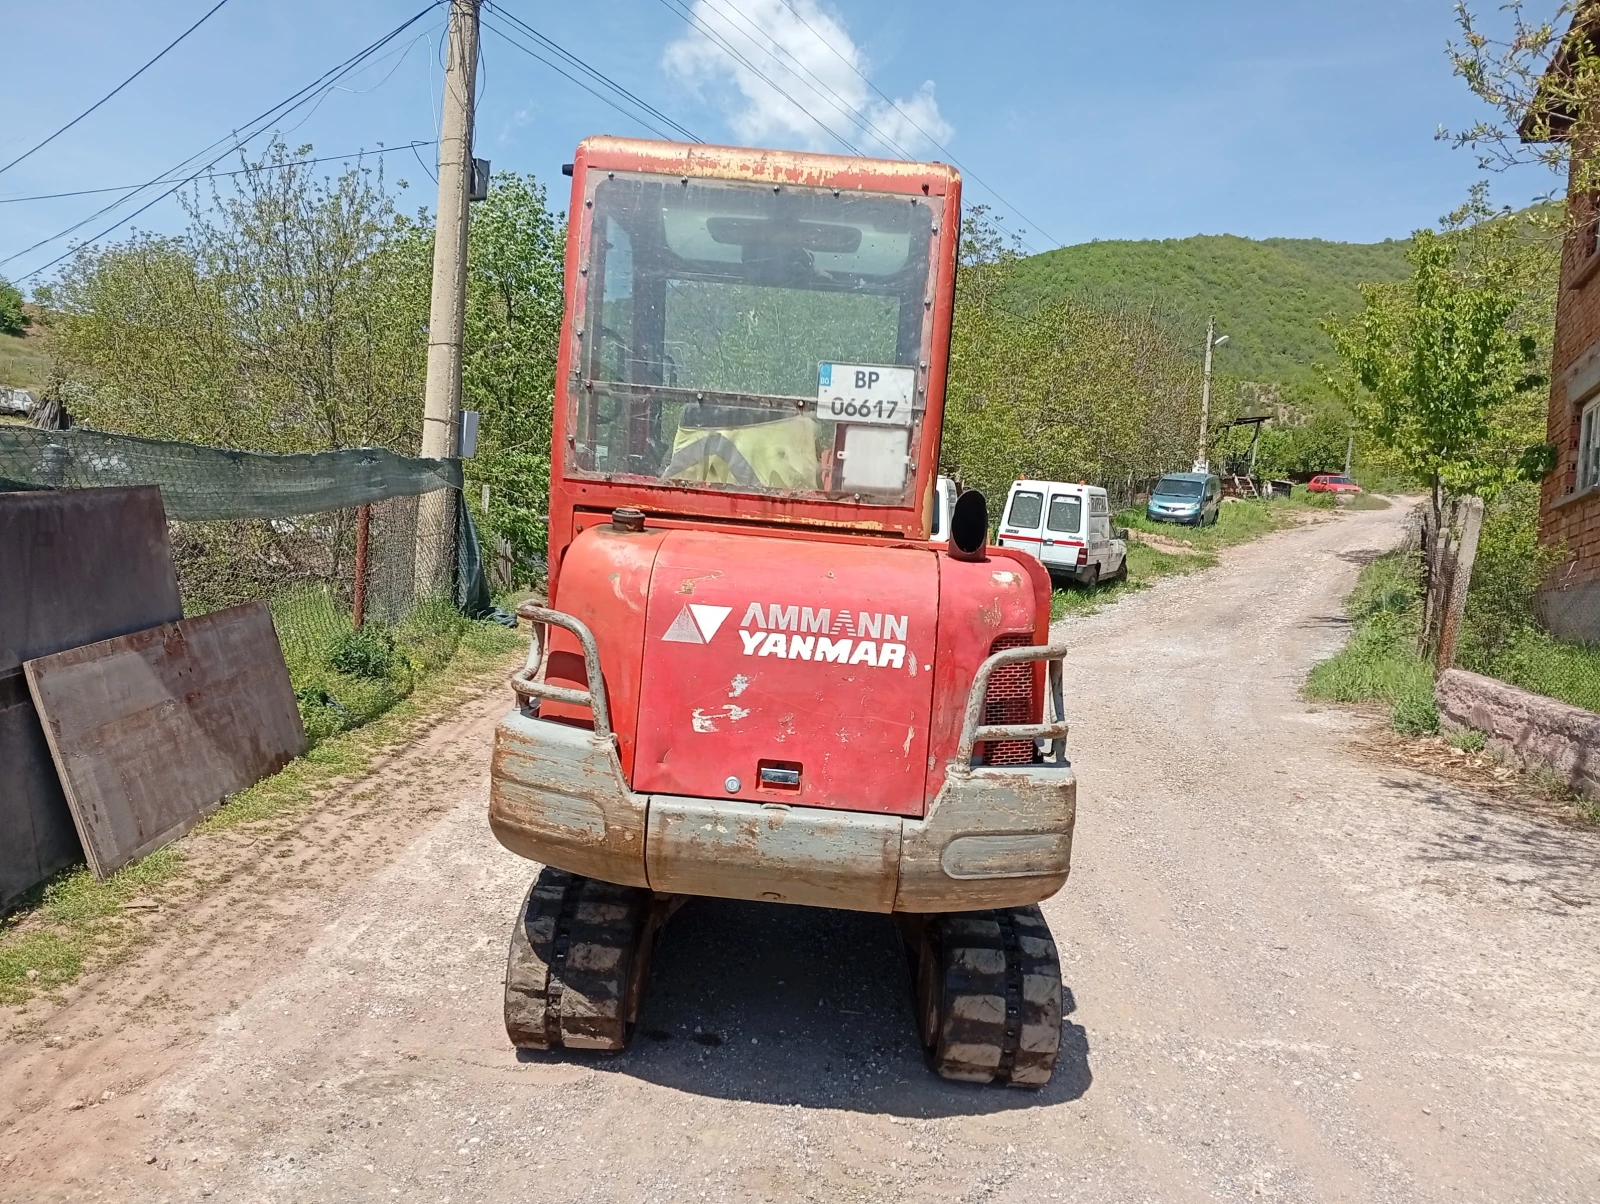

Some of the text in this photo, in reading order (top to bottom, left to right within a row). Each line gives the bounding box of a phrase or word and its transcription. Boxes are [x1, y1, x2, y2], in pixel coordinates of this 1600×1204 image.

[854, 370, 880, 389] BP
[831, 397, 899, 418] 06617
[740, 602, 909, 641] AMMANN
[739, 630, 907, 669] YANMAR
